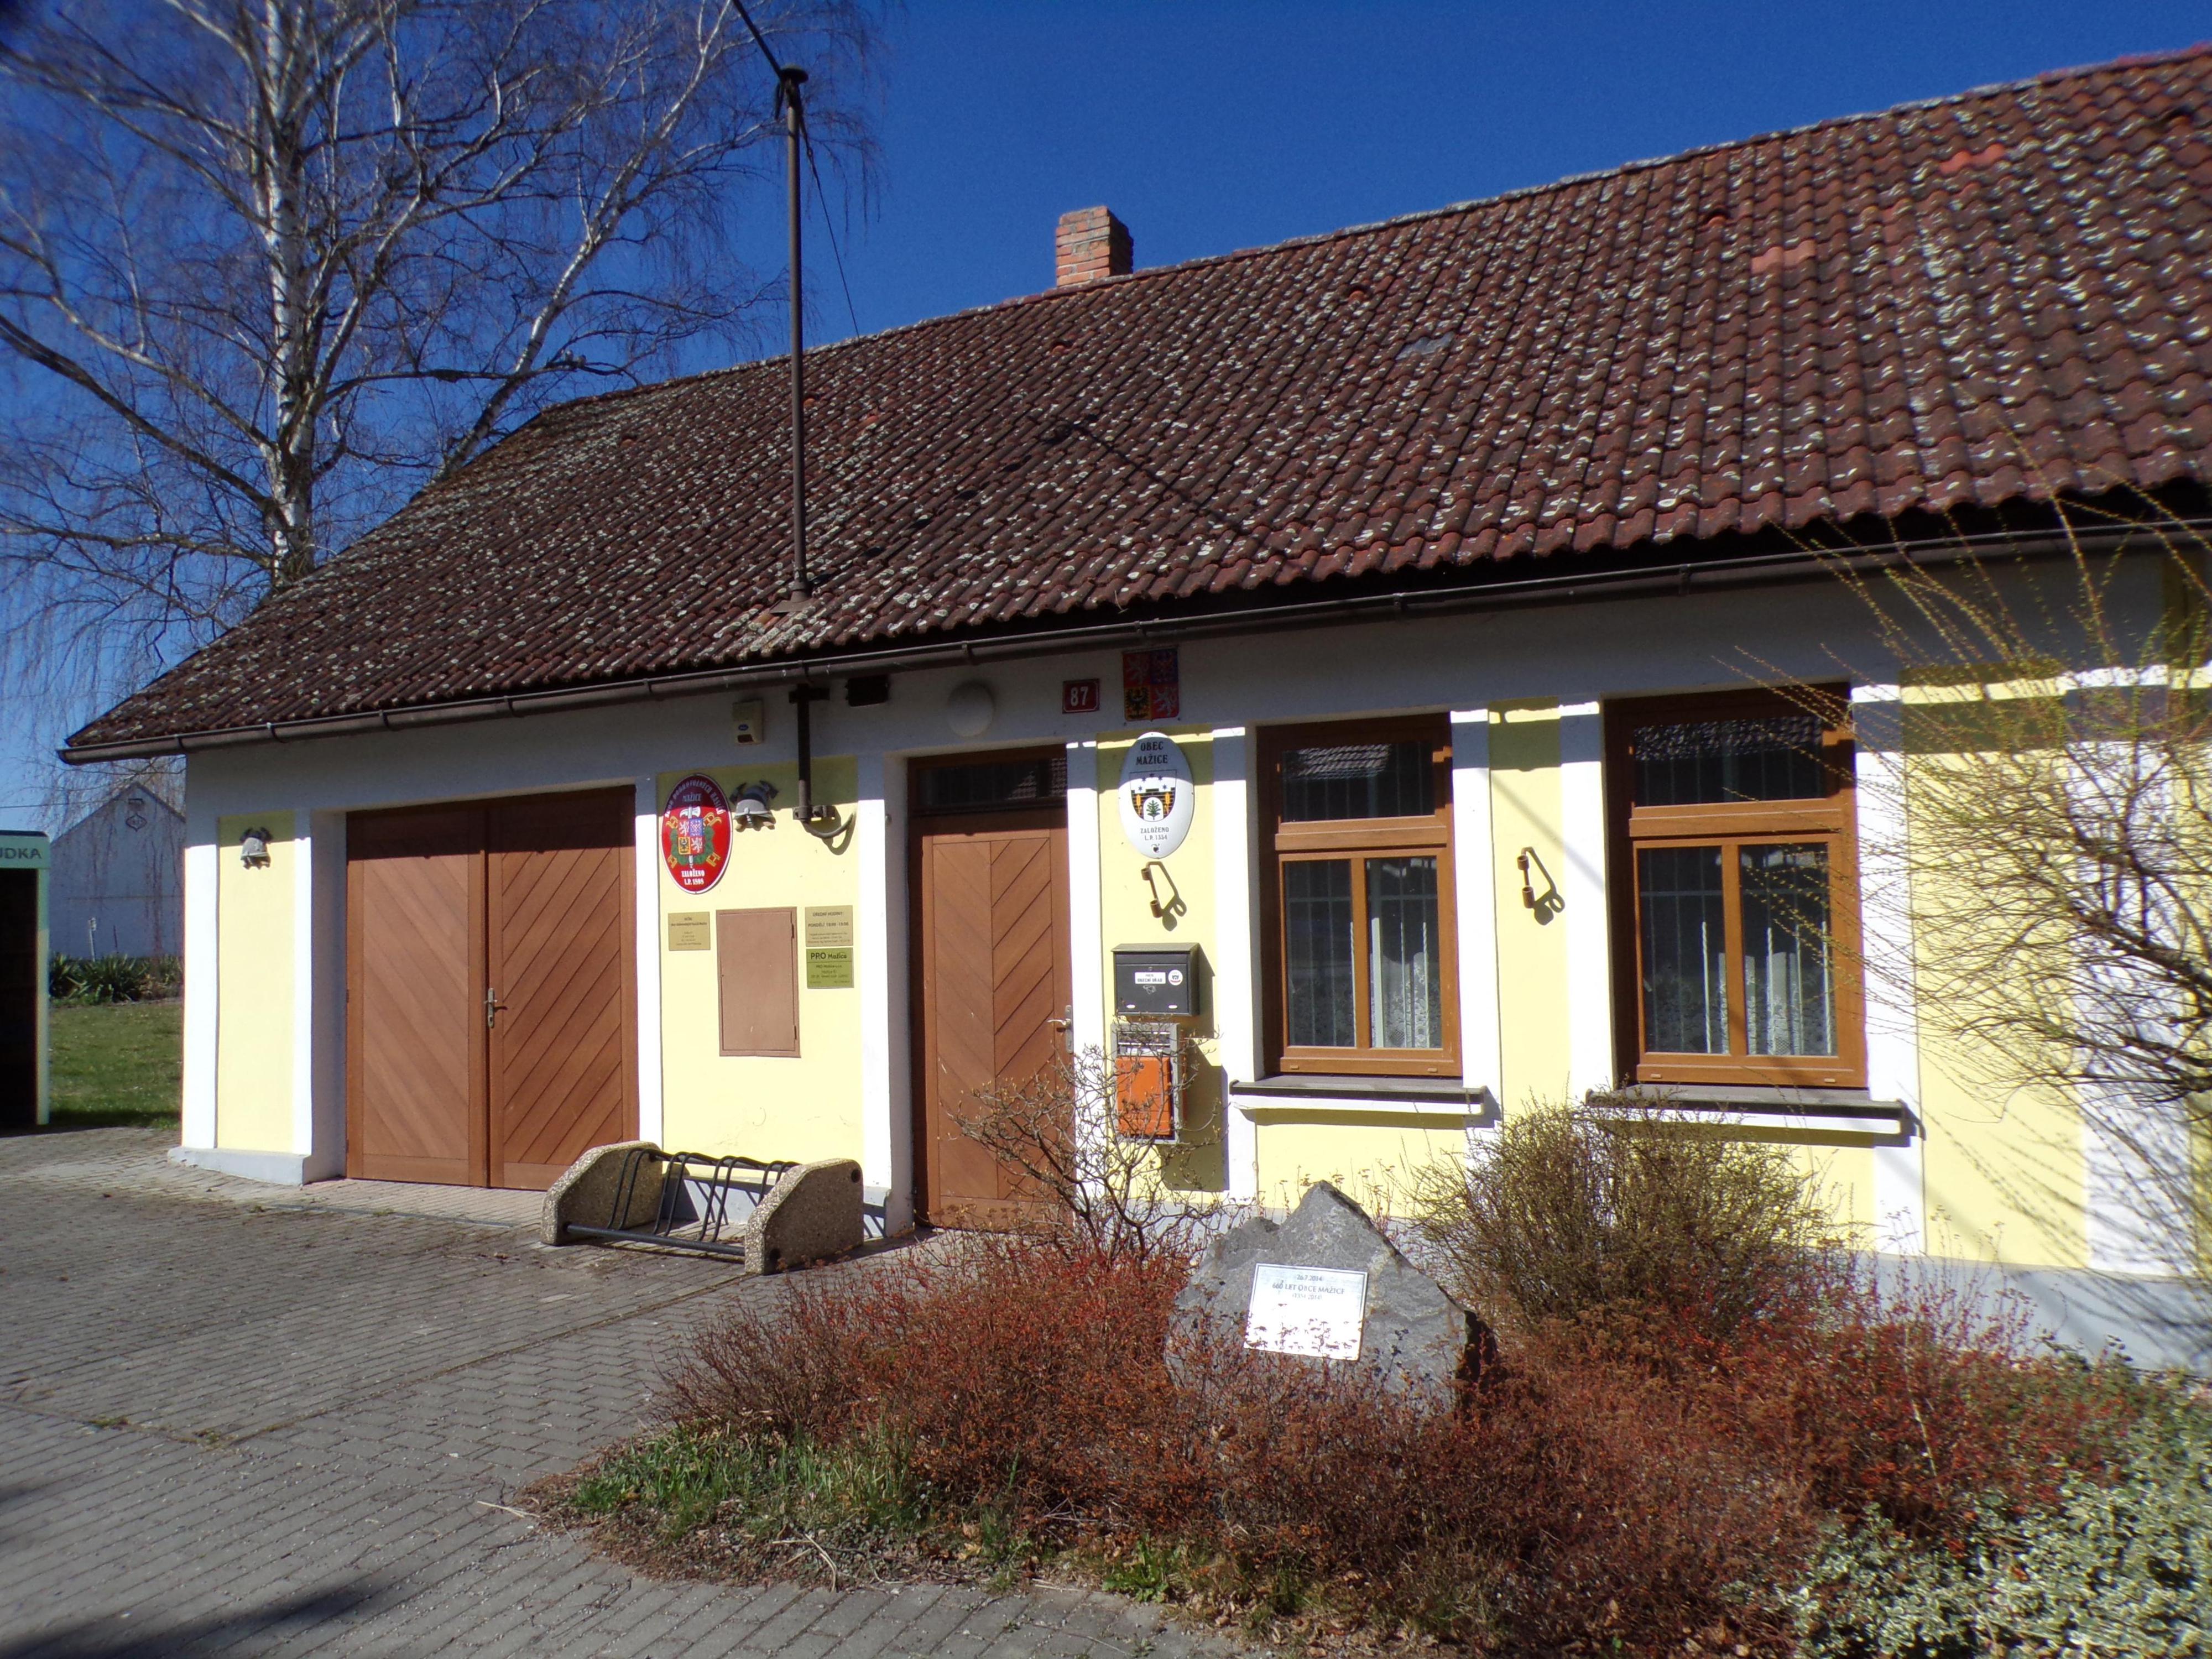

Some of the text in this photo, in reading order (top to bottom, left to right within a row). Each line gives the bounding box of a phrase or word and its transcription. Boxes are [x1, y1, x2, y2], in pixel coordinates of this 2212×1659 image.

[1071, 686, 1088, 707] 87
[1141, 742, 1164, 751] OBEC
[1136, 754, 1168, 765] MAŽICE
[0, 848, 42, 859] DKA
[1318, 1286, 1345, 1295] MAŽICE
